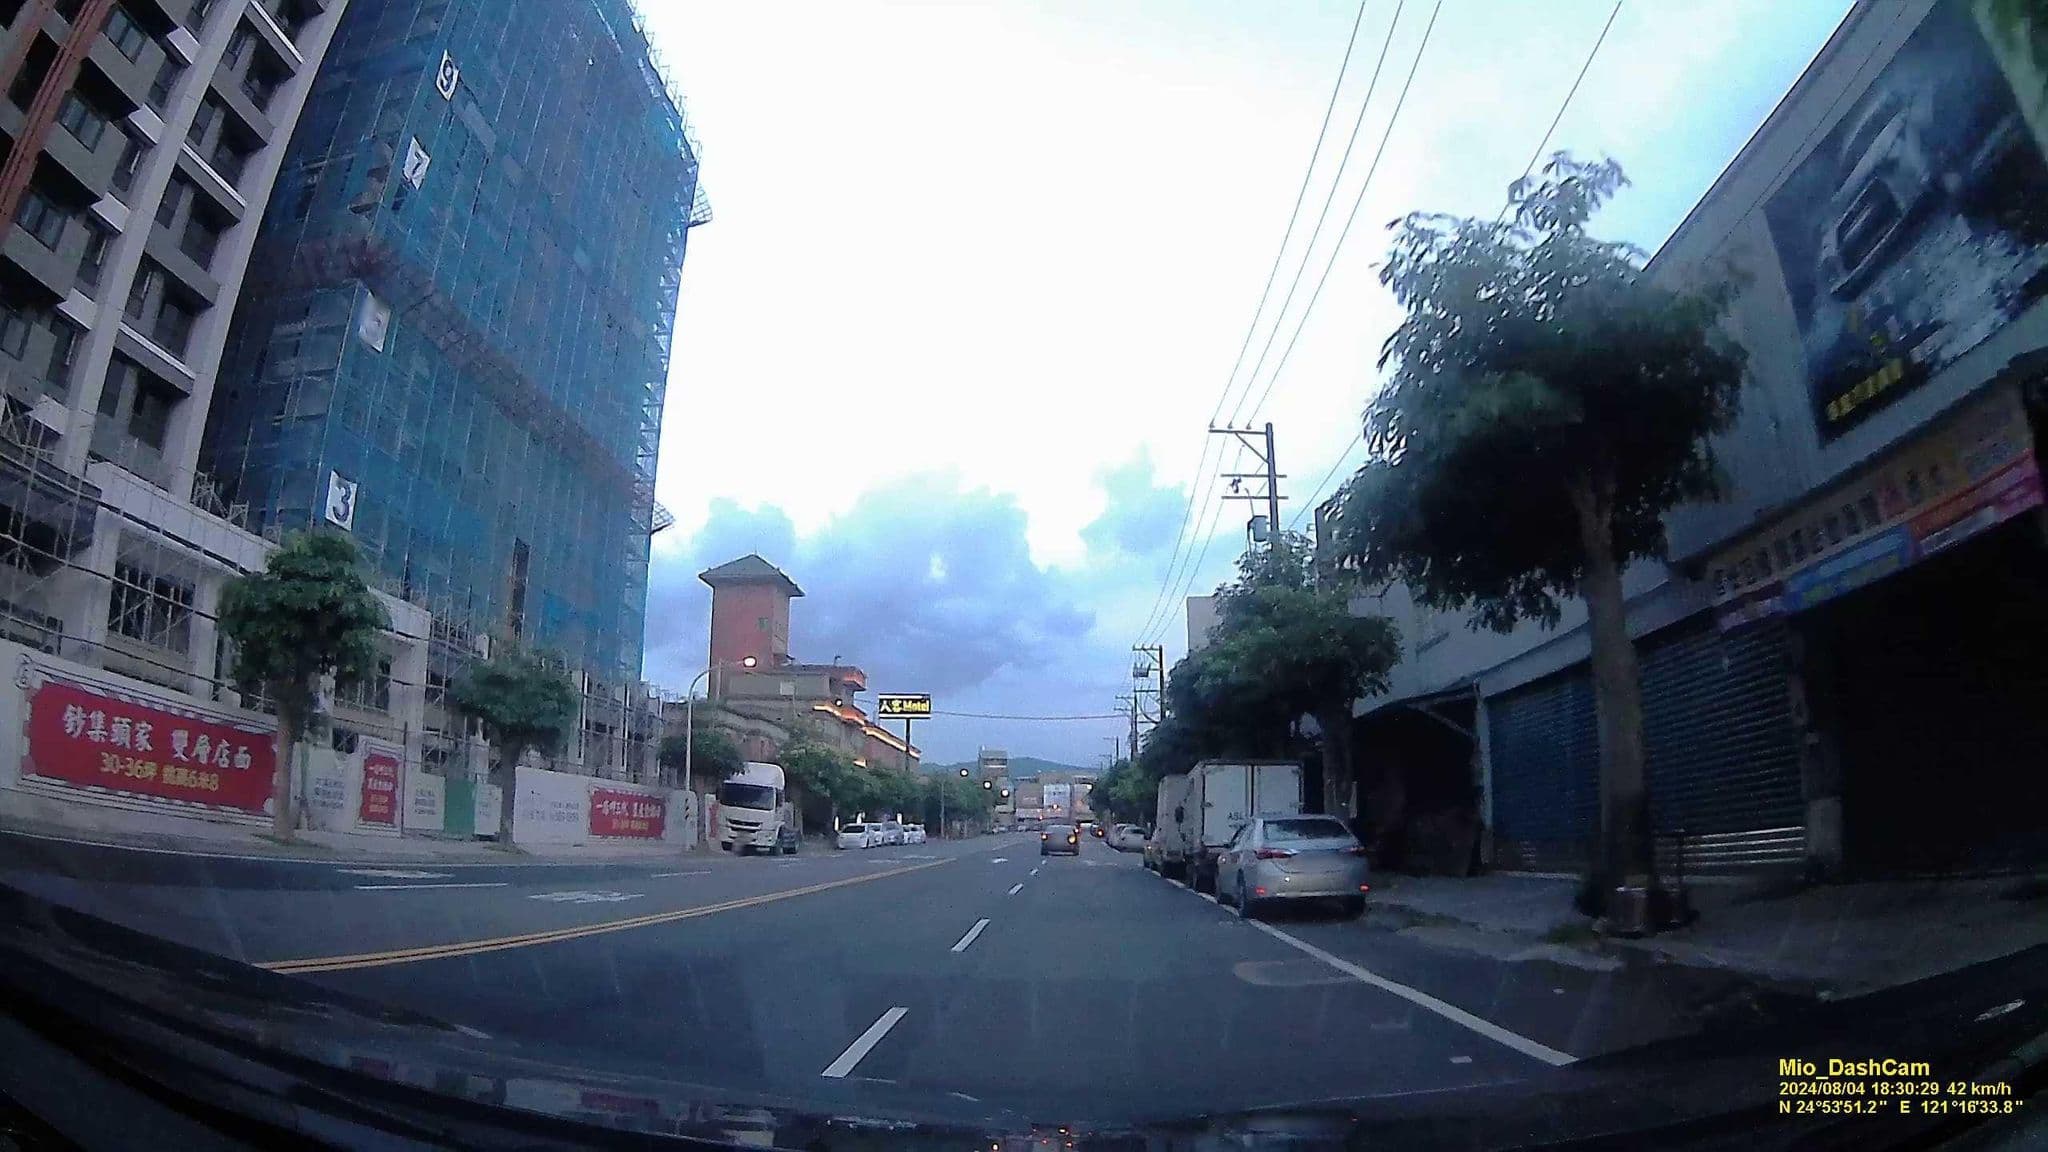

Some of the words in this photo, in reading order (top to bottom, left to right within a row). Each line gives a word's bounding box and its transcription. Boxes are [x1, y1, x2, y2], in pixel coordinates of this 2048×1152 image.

[440, 59, 454, 92] 9
[332, 481, 351, 522] 3
[903, 700, 930, 713] Motel
